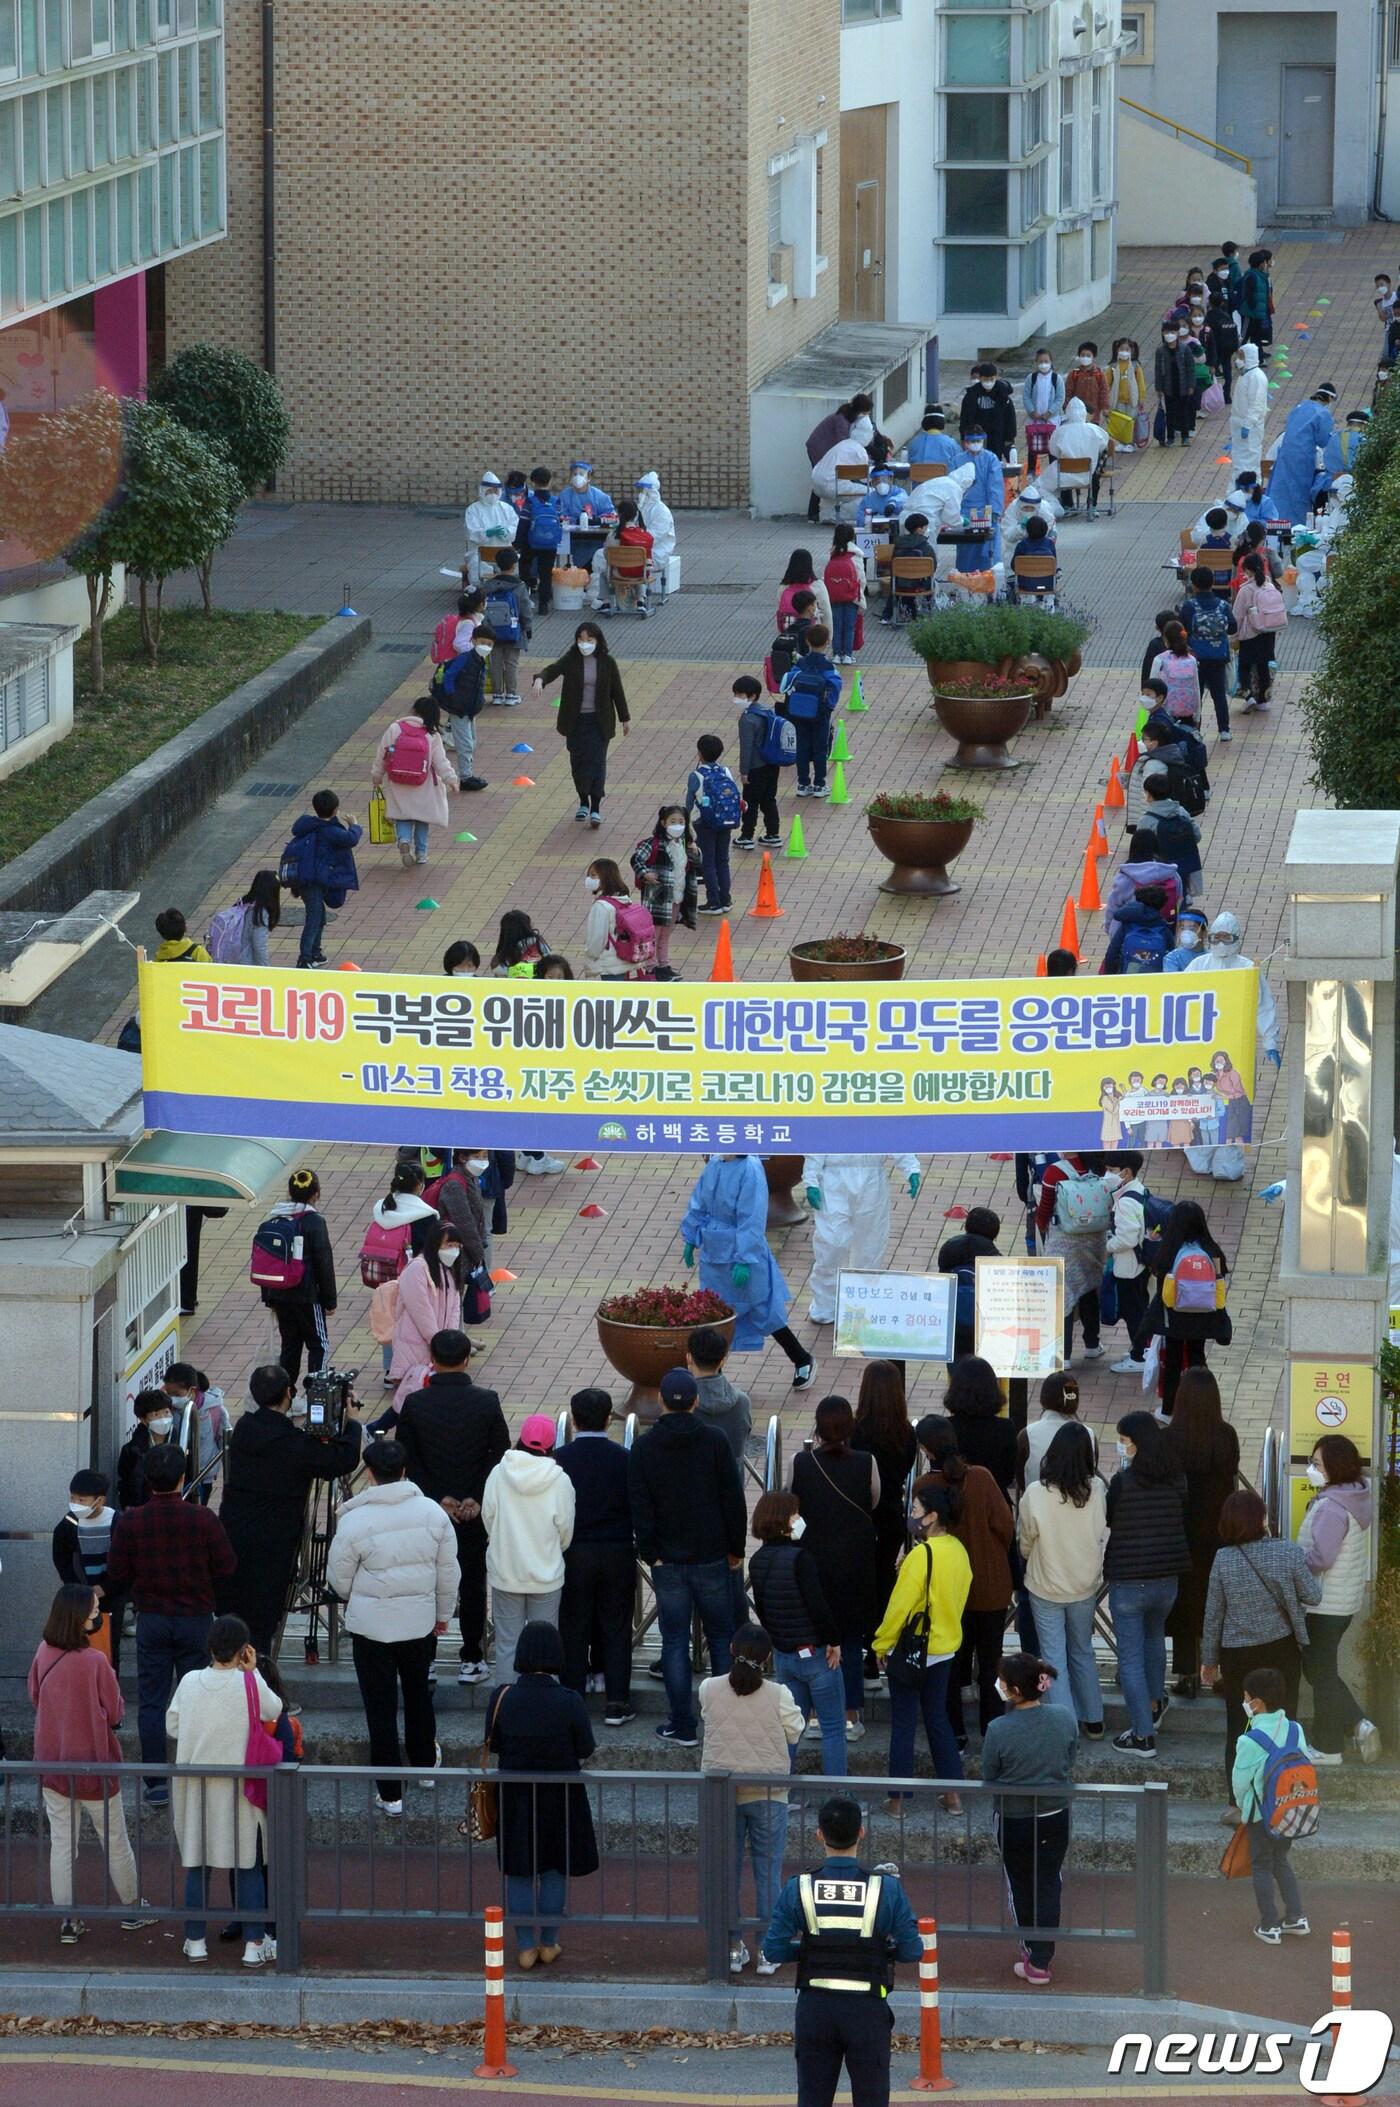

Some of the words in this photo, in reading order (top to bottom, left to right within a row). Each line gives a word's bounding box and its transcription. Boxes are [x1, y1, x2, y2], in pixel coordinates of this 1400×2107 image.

[181, 982, 345, 1041] 코로나19
[353, 992, 475, 1047] 극복을
[483, 996, 565, 1048] 위해
[573, 998, 696, 1051] 애쓰는
[704, 999, 868, 1052] 대한민국
[876, 1000, 1001, 1052] 모두를
[1009, 992, 1218, 1052] 응원합니다
[362, 1064, 443, 1095] 마스크
[450, 1066, 513, 1101] 착용,
[520, 1069, 575, 1100] 자주
[583, 1070, 692, 1102] 손씻기로
[701, 1072, 814, 1103] 코로나19
[821, 1072, 905, 1103] 감염을
[913, 1070, 1052, 1103] 예방합시다
[1123, 1109, 1145, 1117] 우리는
[1136, 1100, 1169, 1109] 코로나19
[635, 1122, 792, 1145] 하백초등학교
[823, 1884, 857, 1900] 경찰
